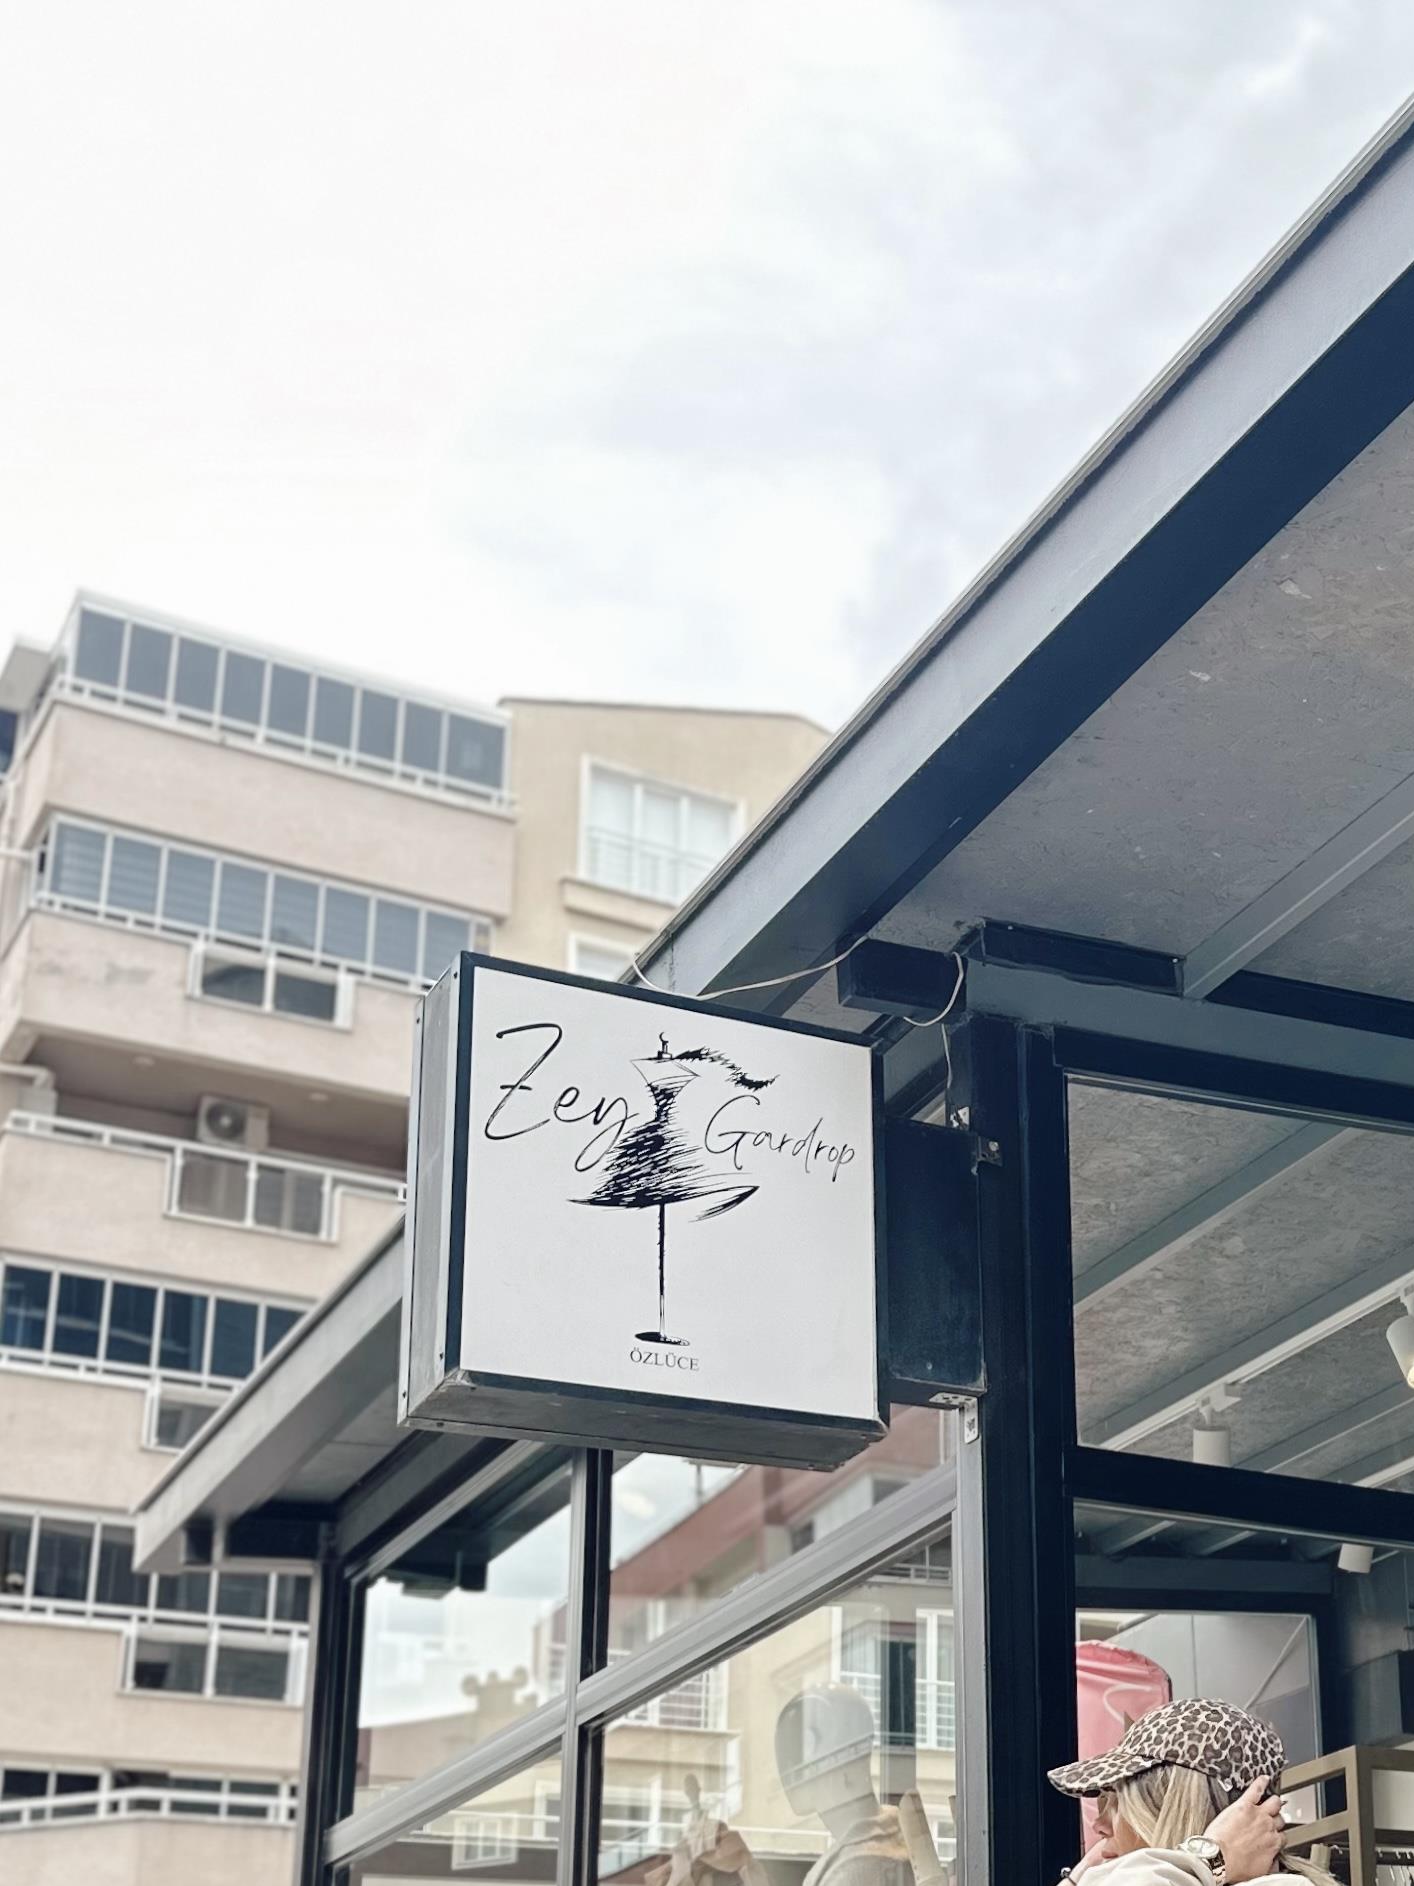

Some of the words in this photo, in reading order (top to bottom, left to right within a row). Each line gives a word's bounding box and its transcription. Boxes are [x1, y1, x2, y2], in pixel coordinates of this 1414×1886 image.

[484, 1022, 638, 1172] Zey
[705, 1094, 856, 1182] Gardrop
[630, 1347, 700, 1372] ÖZLÜCE
